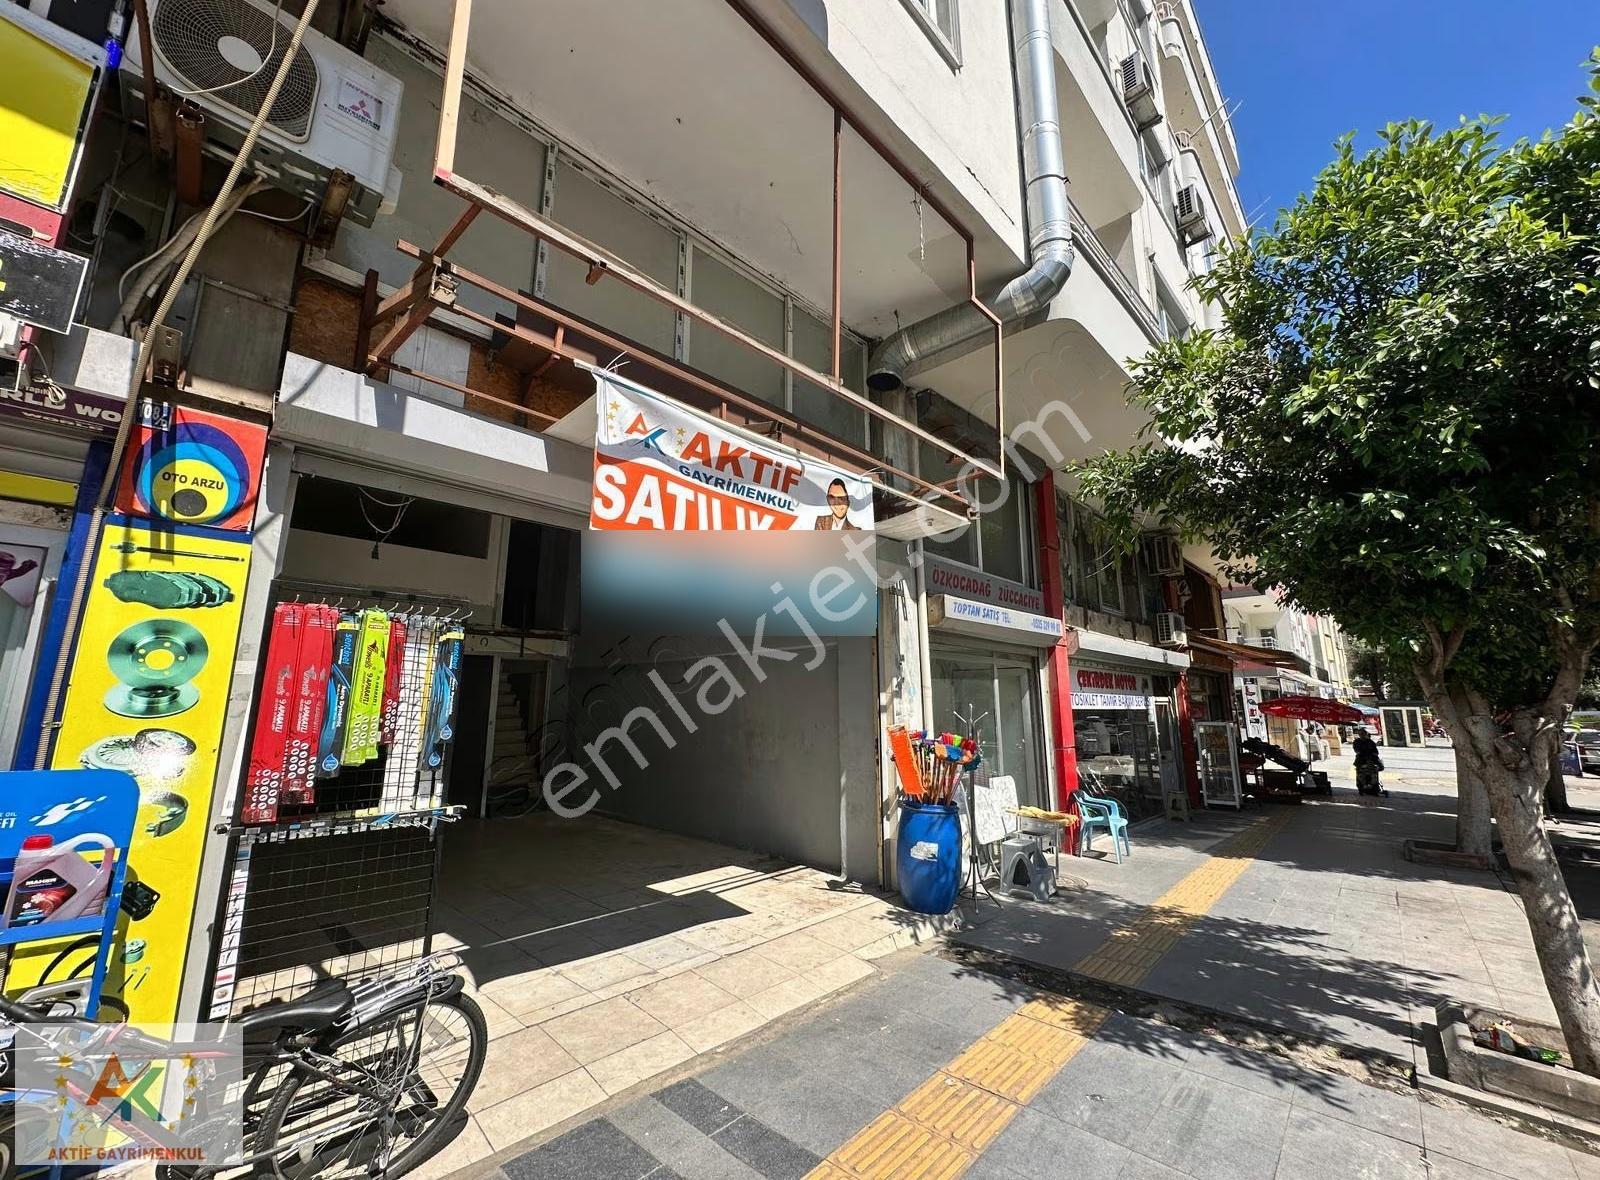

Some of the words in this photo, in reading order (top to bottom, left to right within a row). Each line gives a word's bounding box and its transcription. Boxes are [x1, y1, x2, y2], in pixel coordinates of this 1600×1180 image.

[162, 471, 188, 484] OTO
[191, 477, 225, 490] ARZU
[679, 465, 795, 511] GAYRİMENKUL
[953, 602, 980, 617] TOPTAN
[343, 633, 353, 665] sentinel
